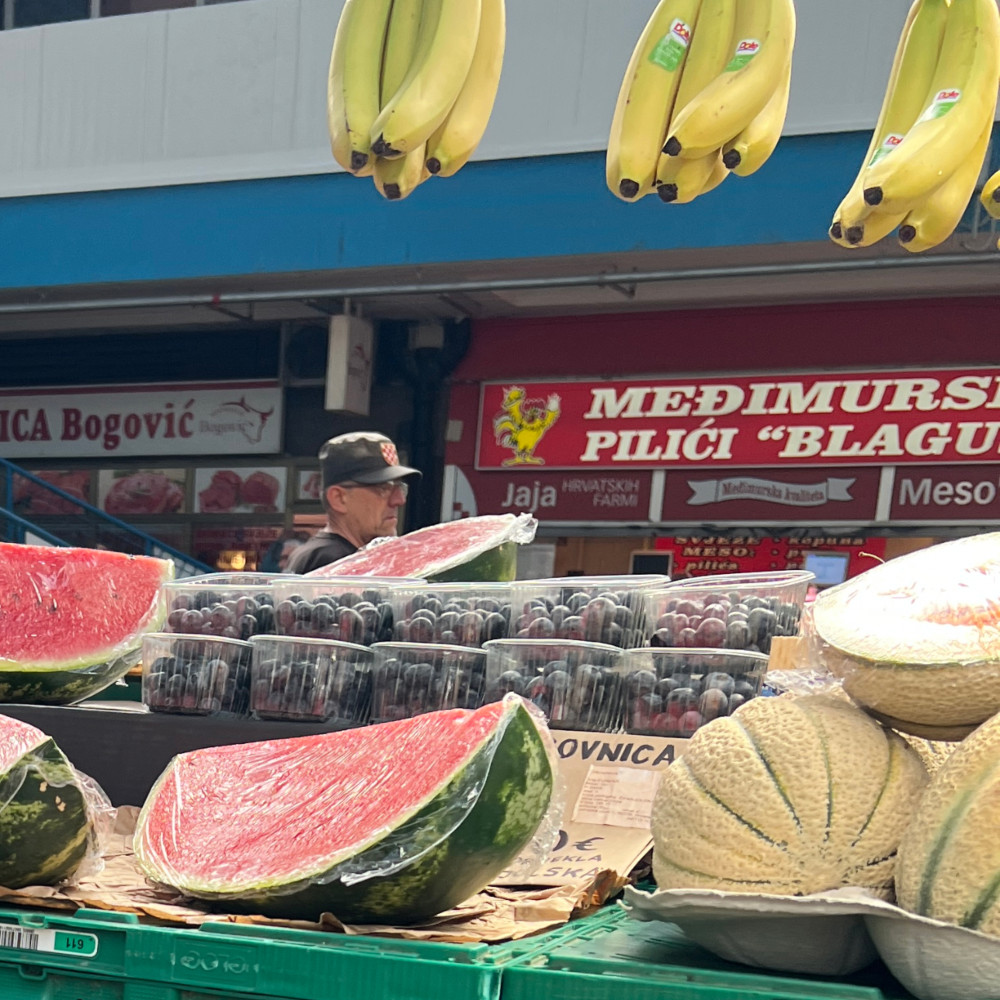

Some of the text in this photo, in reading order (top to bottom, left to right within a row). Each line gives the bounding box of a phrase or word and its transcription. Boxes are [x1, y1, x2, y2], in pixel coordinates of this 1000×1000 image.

[60, 399, 195, 450] Bogović
[580, 418, 1000, 462] PILIĆI “BLAGU
[502, 481, 557, 512] Jaja
[562, 478, 640, 492] HRVATSKIH
[899, 478, 996, 505] Meso
[593, 494, 638, 507] FARMI
[554, 738, 676, 766] OVNICA
